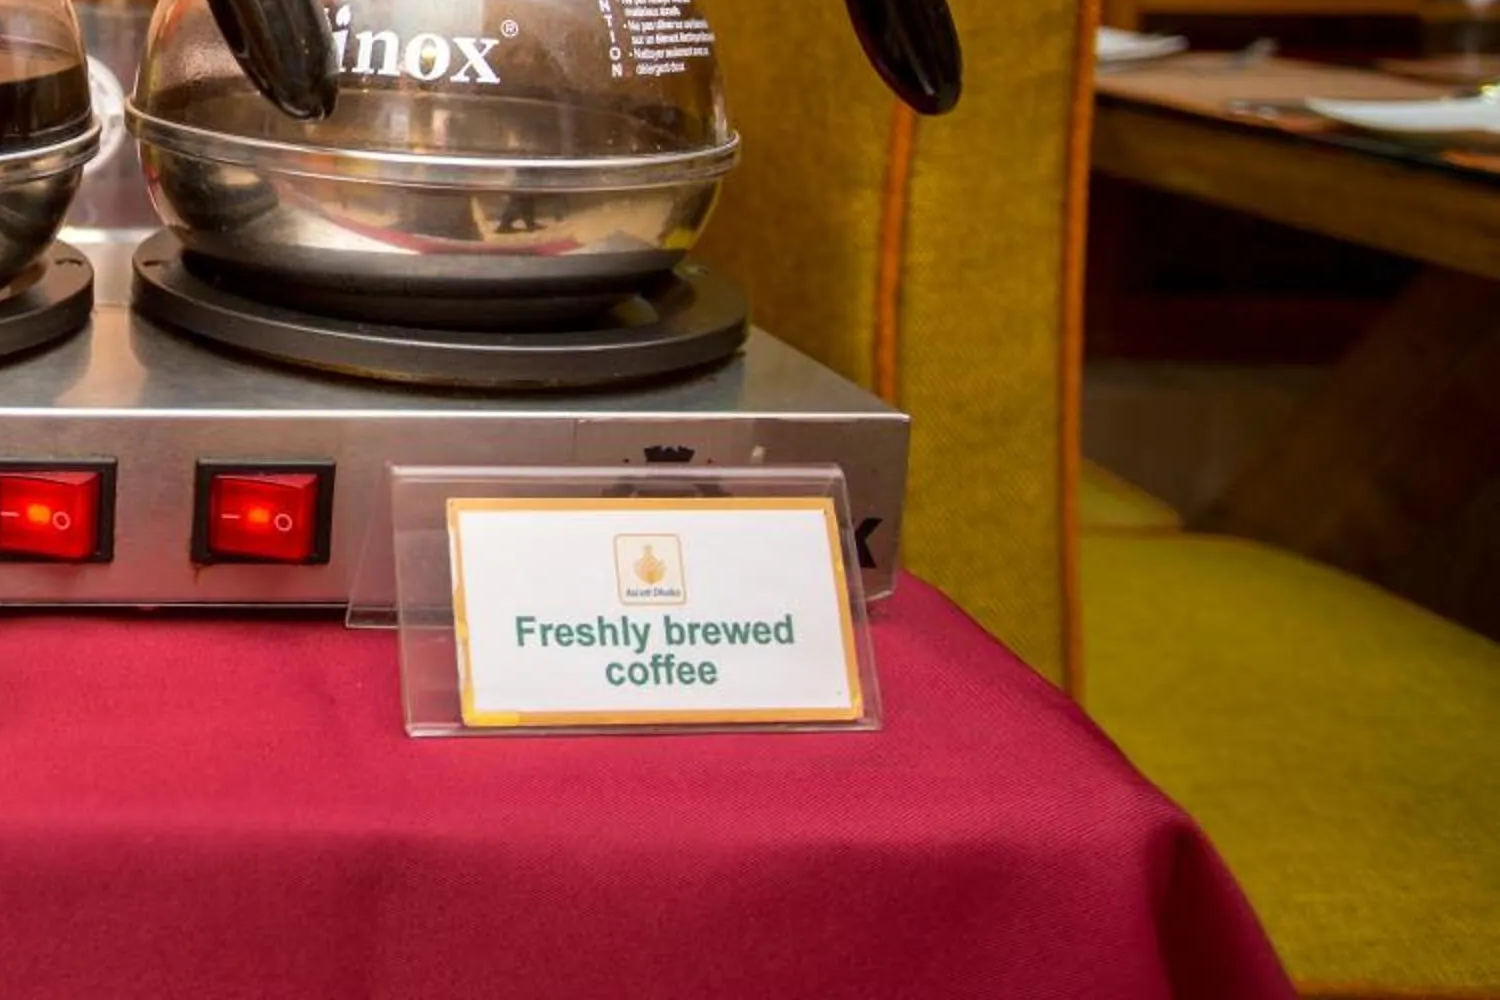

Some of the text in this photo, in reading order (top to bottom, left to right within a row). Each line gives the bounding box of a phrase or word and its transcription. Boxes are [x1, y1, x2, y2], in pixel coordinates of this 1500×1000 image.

[324, 4, 501, 84] inox
[516, 615, 795, 653] Freshly brewed
[606, 653, 719, 685] coffee
